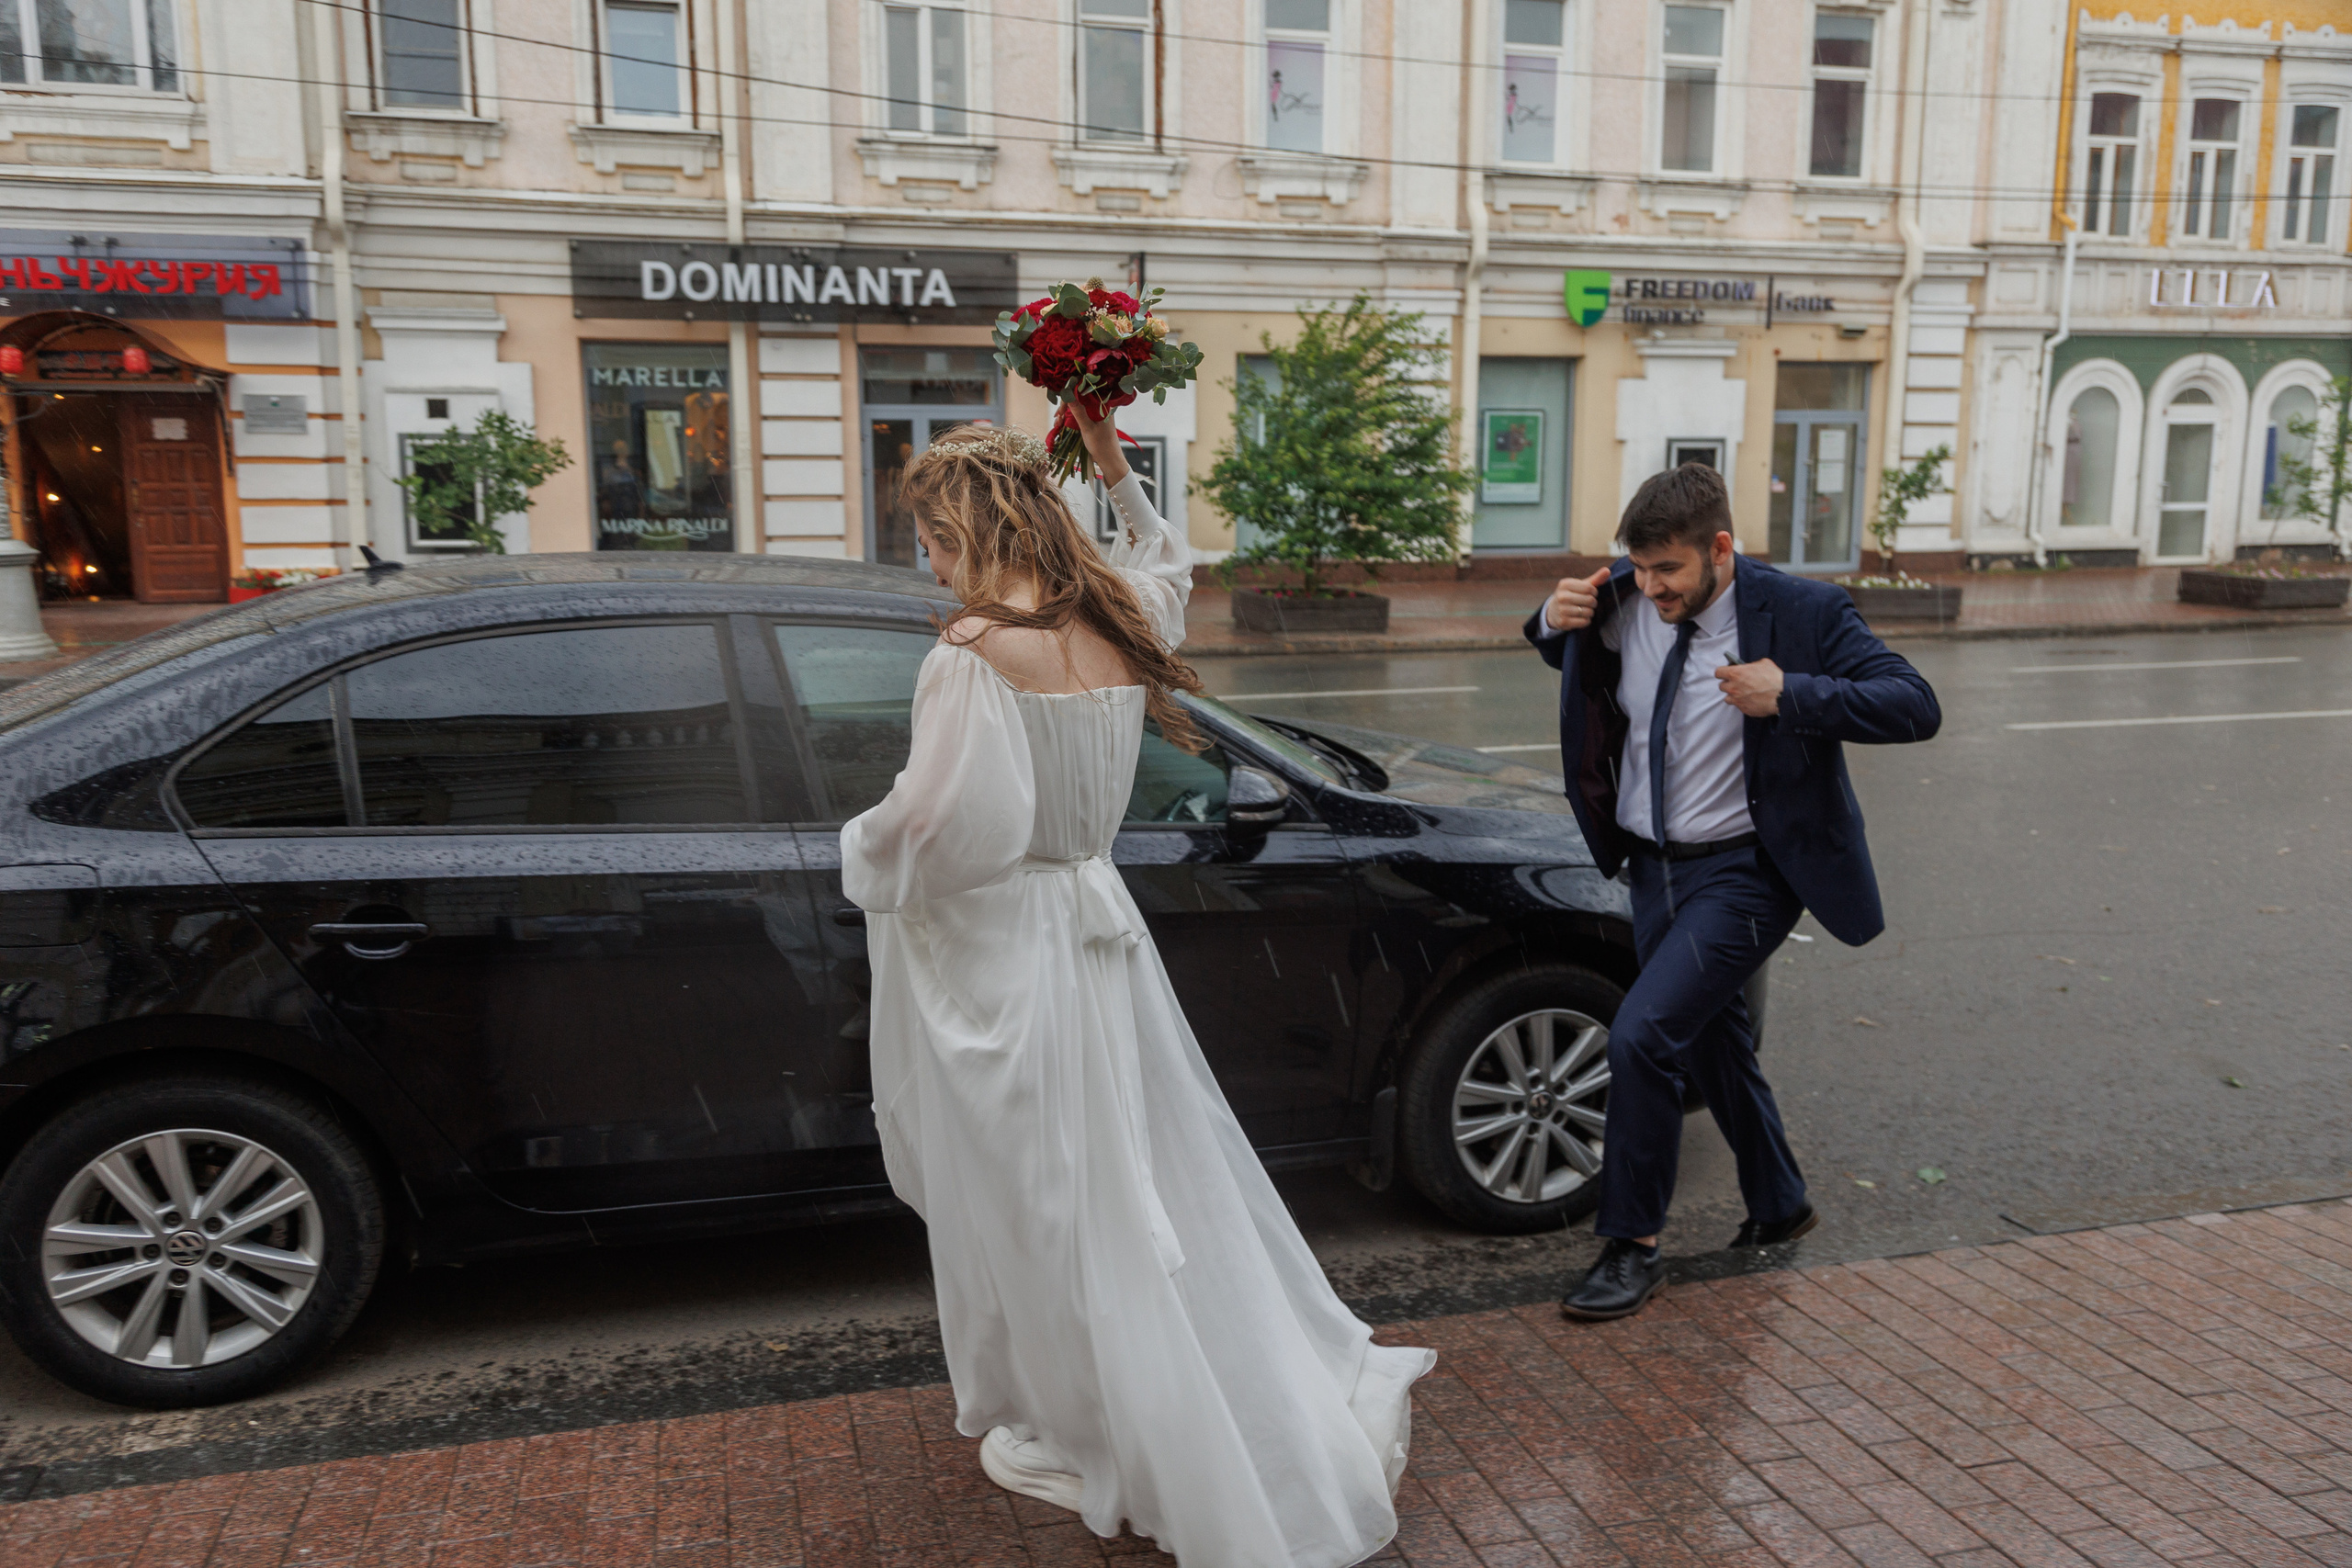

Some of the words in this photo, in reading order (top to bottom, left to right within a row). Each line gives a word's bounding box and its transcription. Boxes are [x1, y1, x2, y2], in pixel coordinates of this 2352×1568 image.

[0, 255, 282, 300] НЬЧЖУРИЯ
[640, 260, 956, 307] DOMINANTA
[1624, 278, 1756, 300] FREEDOM
[1623, 302, 1704, 324] finance
[593, 367, 723, 388] MARELLA
[601, 517, 663, 537] MARINA
[666, 517, 729, 537] RINALDI
